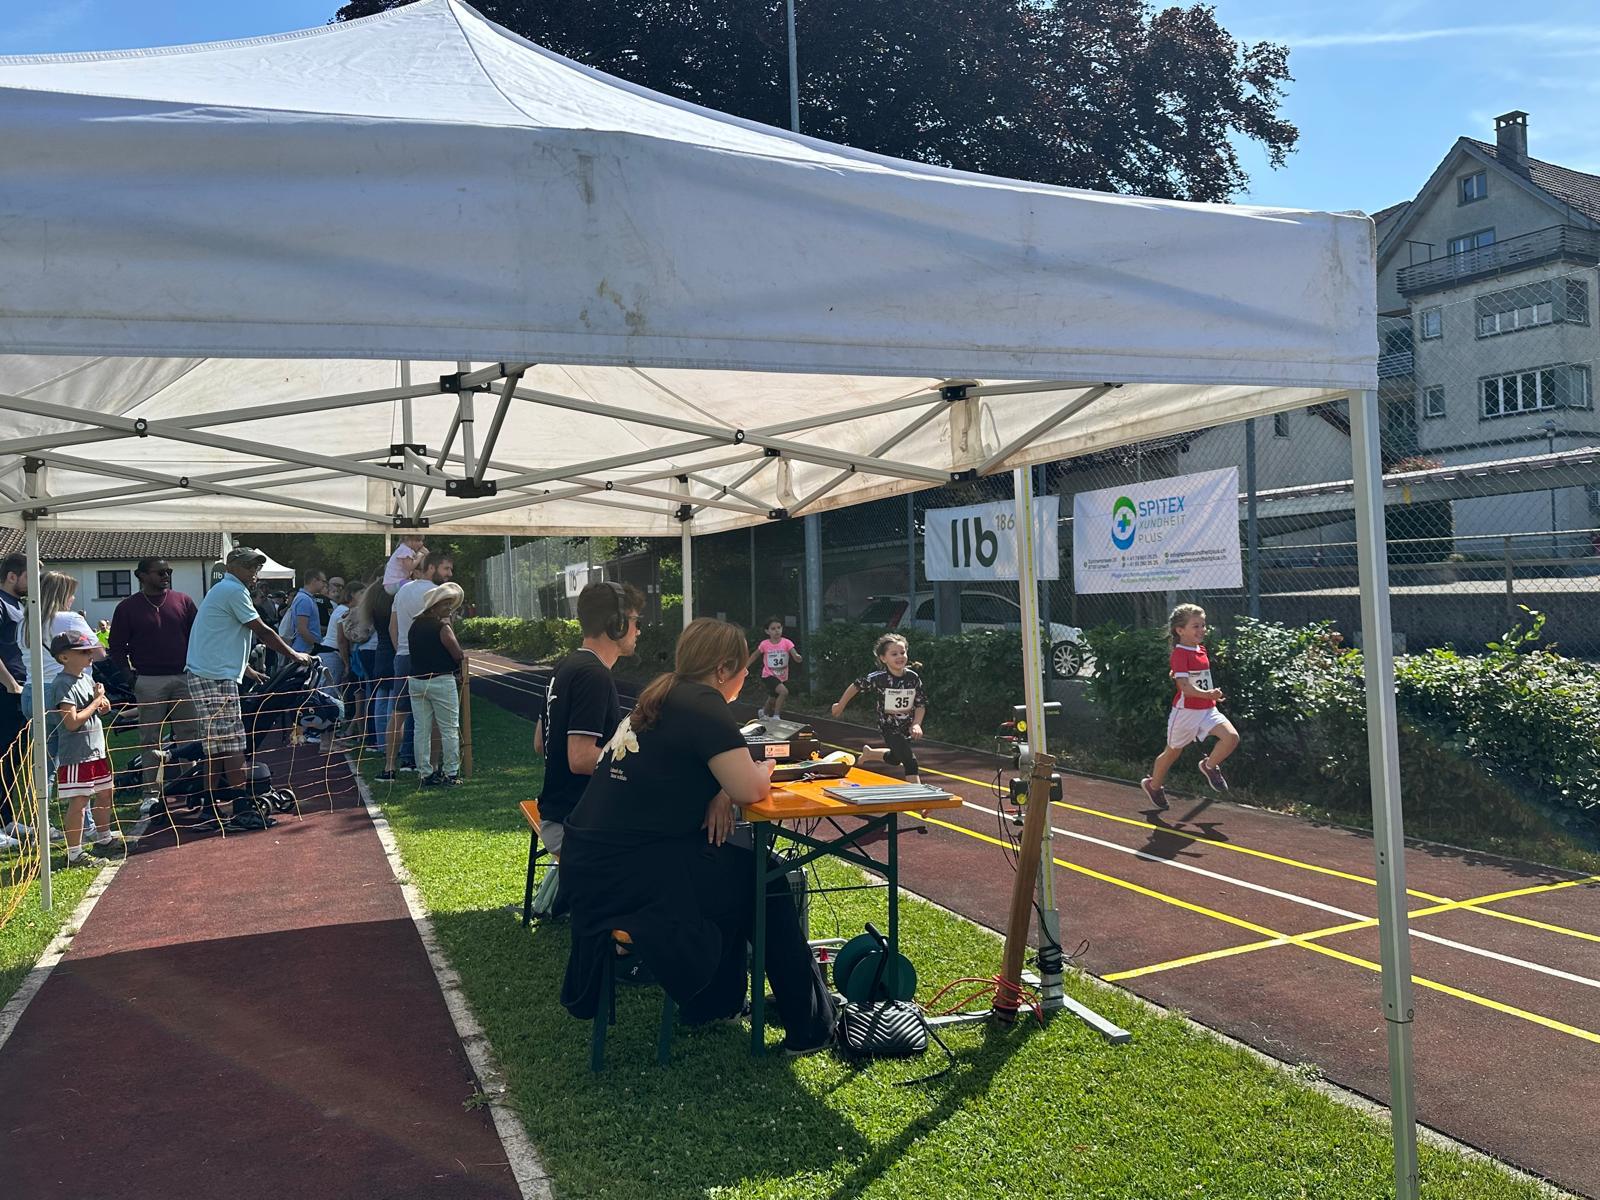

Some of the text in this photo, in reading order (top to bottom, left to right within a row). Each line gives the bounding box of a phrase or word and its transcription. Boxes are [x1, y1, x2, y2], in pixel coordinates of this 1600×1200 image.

[1138, 495, 1185, 517] SPITEX
[1138, 513, 1186, 530] XUNDHEIT
[1138, 531, 1164, 544] PLUS
[773, 658, 784, 666] 34
[895, 696, 909, 708] 35
